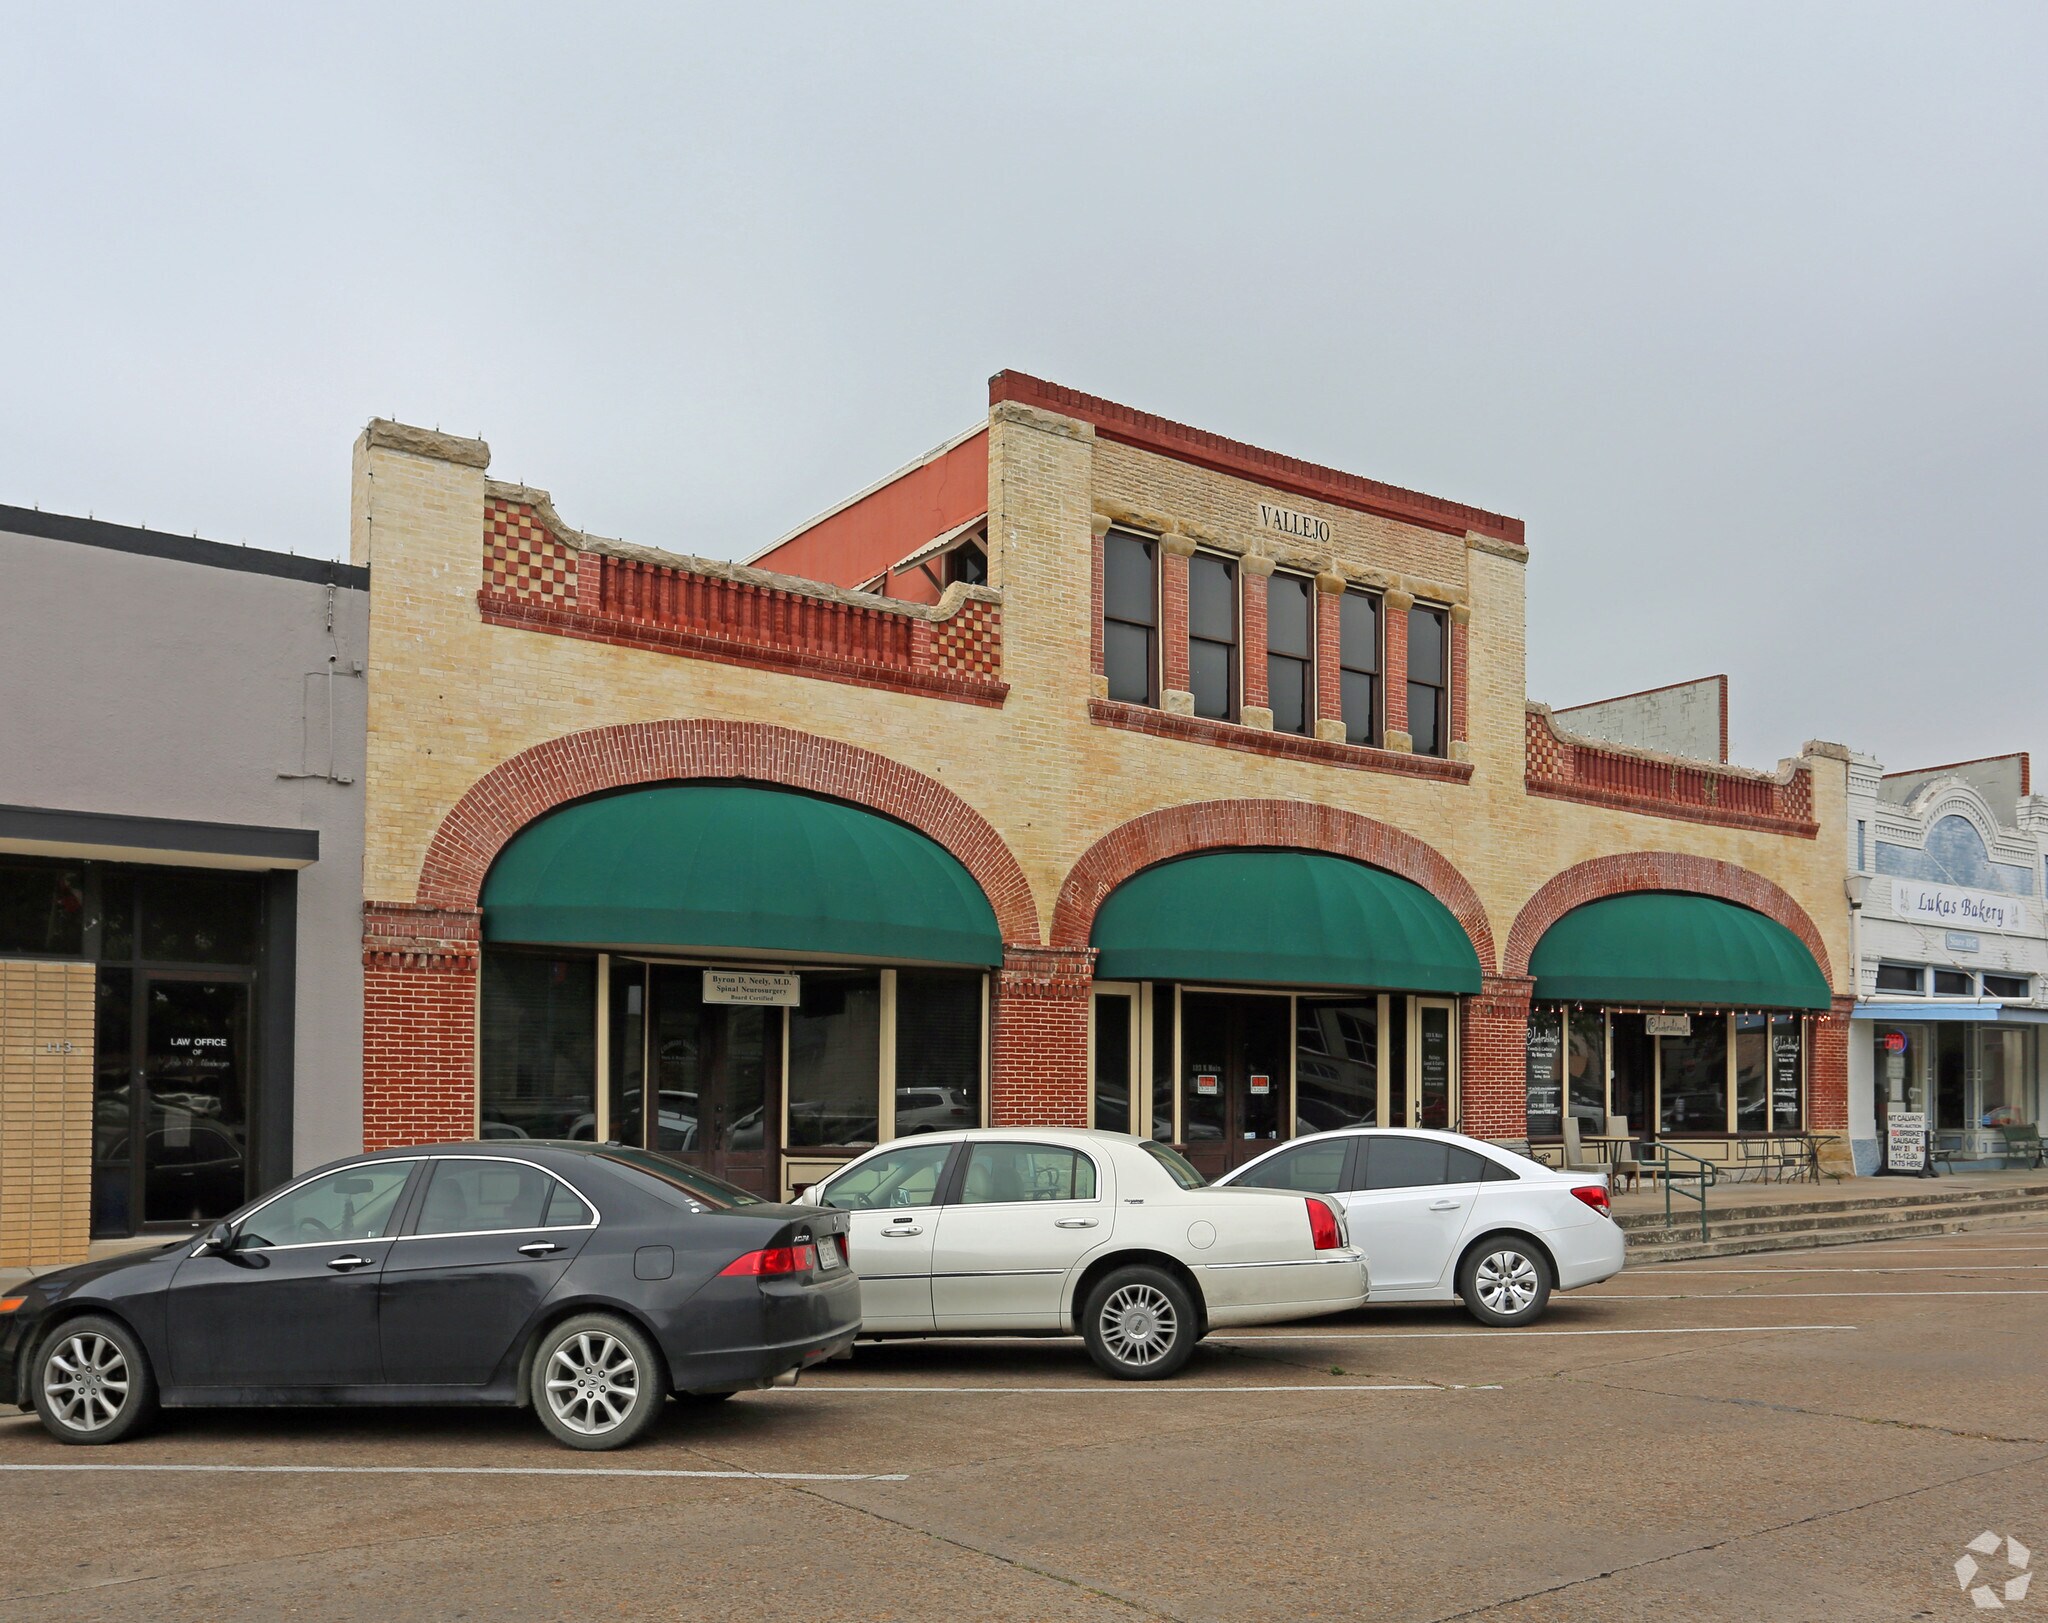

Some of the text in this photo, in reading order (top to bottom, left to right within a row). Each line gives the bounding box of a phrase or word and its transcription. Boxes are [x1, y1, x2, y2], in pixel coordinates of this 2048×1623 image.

[1261, 504, 1330, 542] VALLEJO
[1918, 892, 2004, 928] Lukas Bakery
[712, 976, 736, 984] Byron
[750, 977, 770, 986] Neely,
[742, 986, 786, 996] Neurosurgery
[46, 1041, 72, 1053] 113
[170, 1038, 227, 1046] LAW OFFICE
[1884, 1034, 1904, 1049] OPEN
